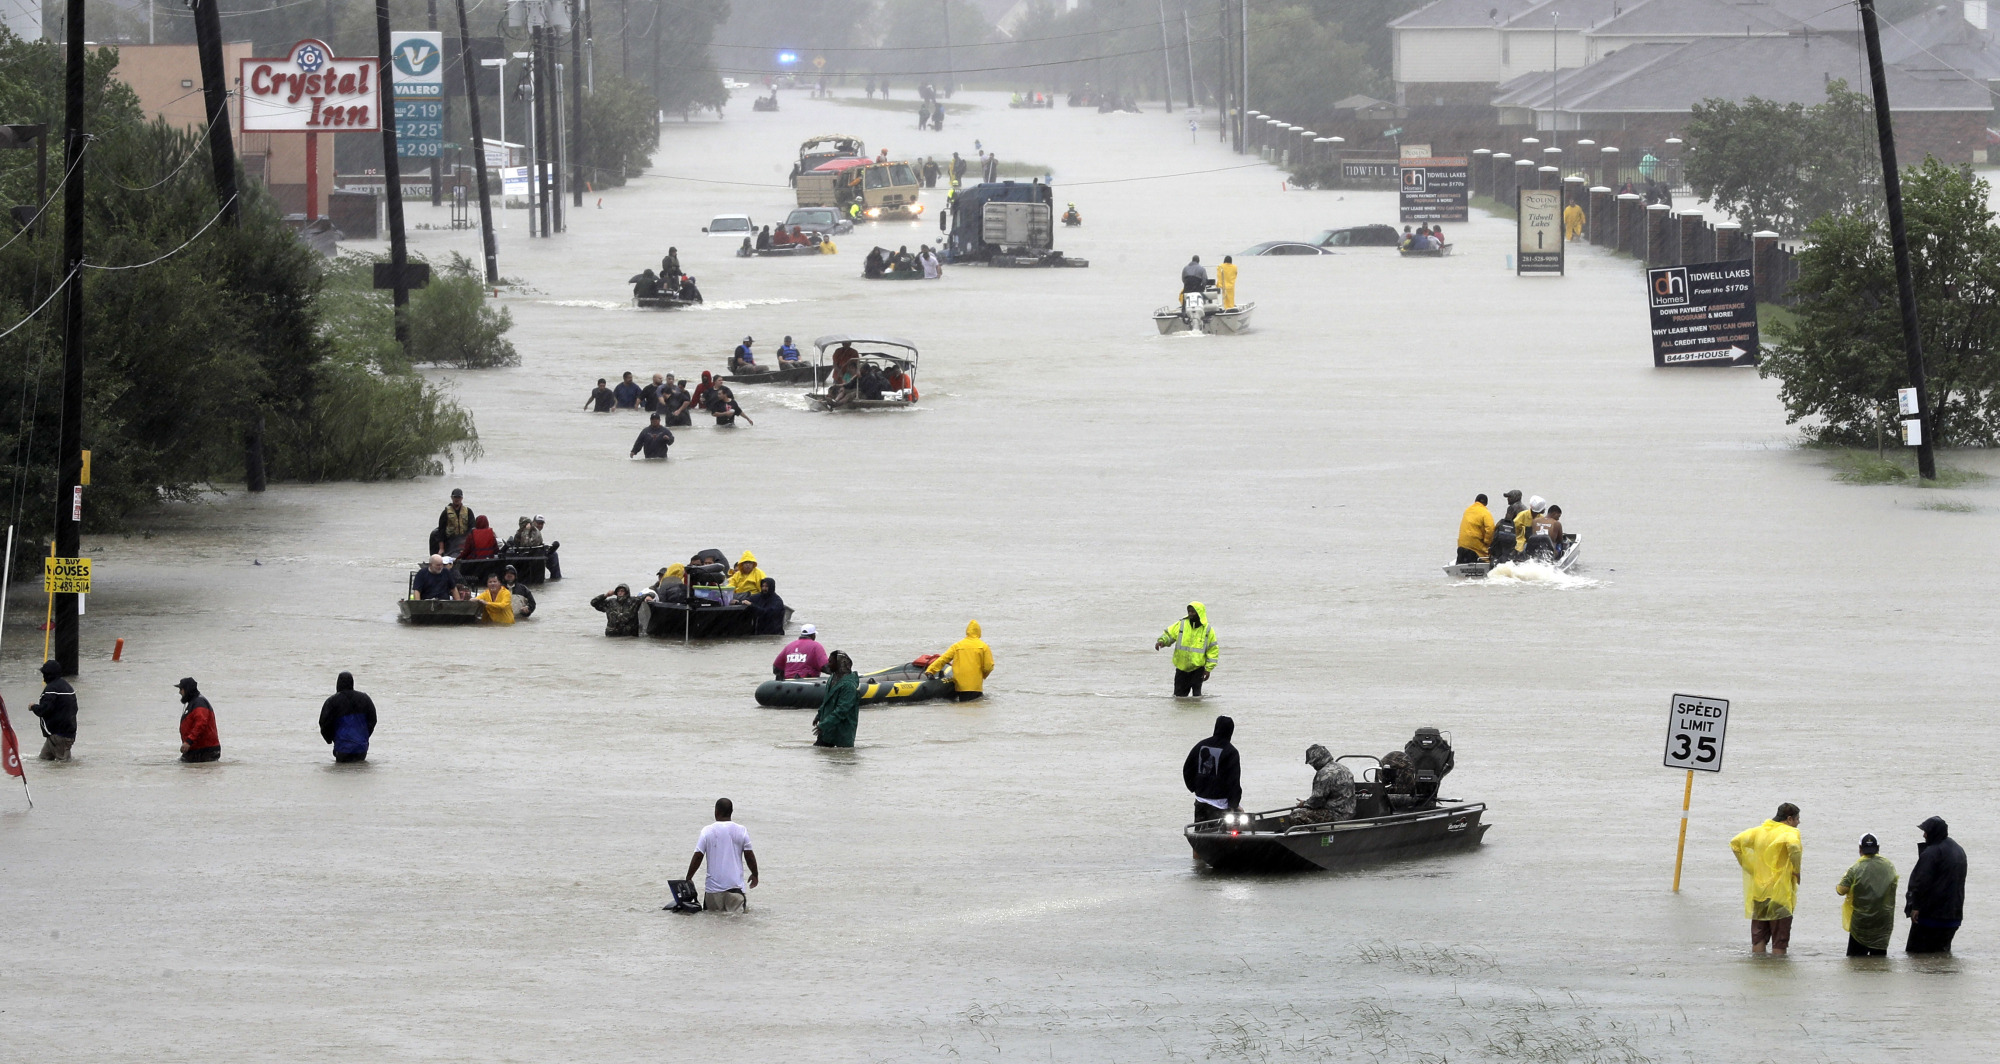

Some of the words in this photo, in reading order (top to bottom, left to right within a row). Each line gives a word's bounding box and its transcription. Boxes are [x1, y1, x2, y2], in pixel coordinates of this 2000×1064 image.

[251, 64, 369, 104] Crystal
[394, 86, 440, 94] VALERO
[306, 97, 369, 126] Inn
[402, 187, 432, 196] ANCH
[1690, 271, 1723, 281] TIDWELL
[1725, 269, 1750, 279] LAKES
[1655, 271, 1683, 295] dh
[1725, 284, 1748, 293] $170s
[1679, 306, 1707, 314] PAYMENT
[1667, 350, 1730, 362] 844-91-HOUSE
[46, 582, 89, 592] 73-489-5114
[1677, 703, 1722, 718] SPEED
[1681, 719, 1714, 732] LIMIT
[1671, 734, 1716, 763] 35
